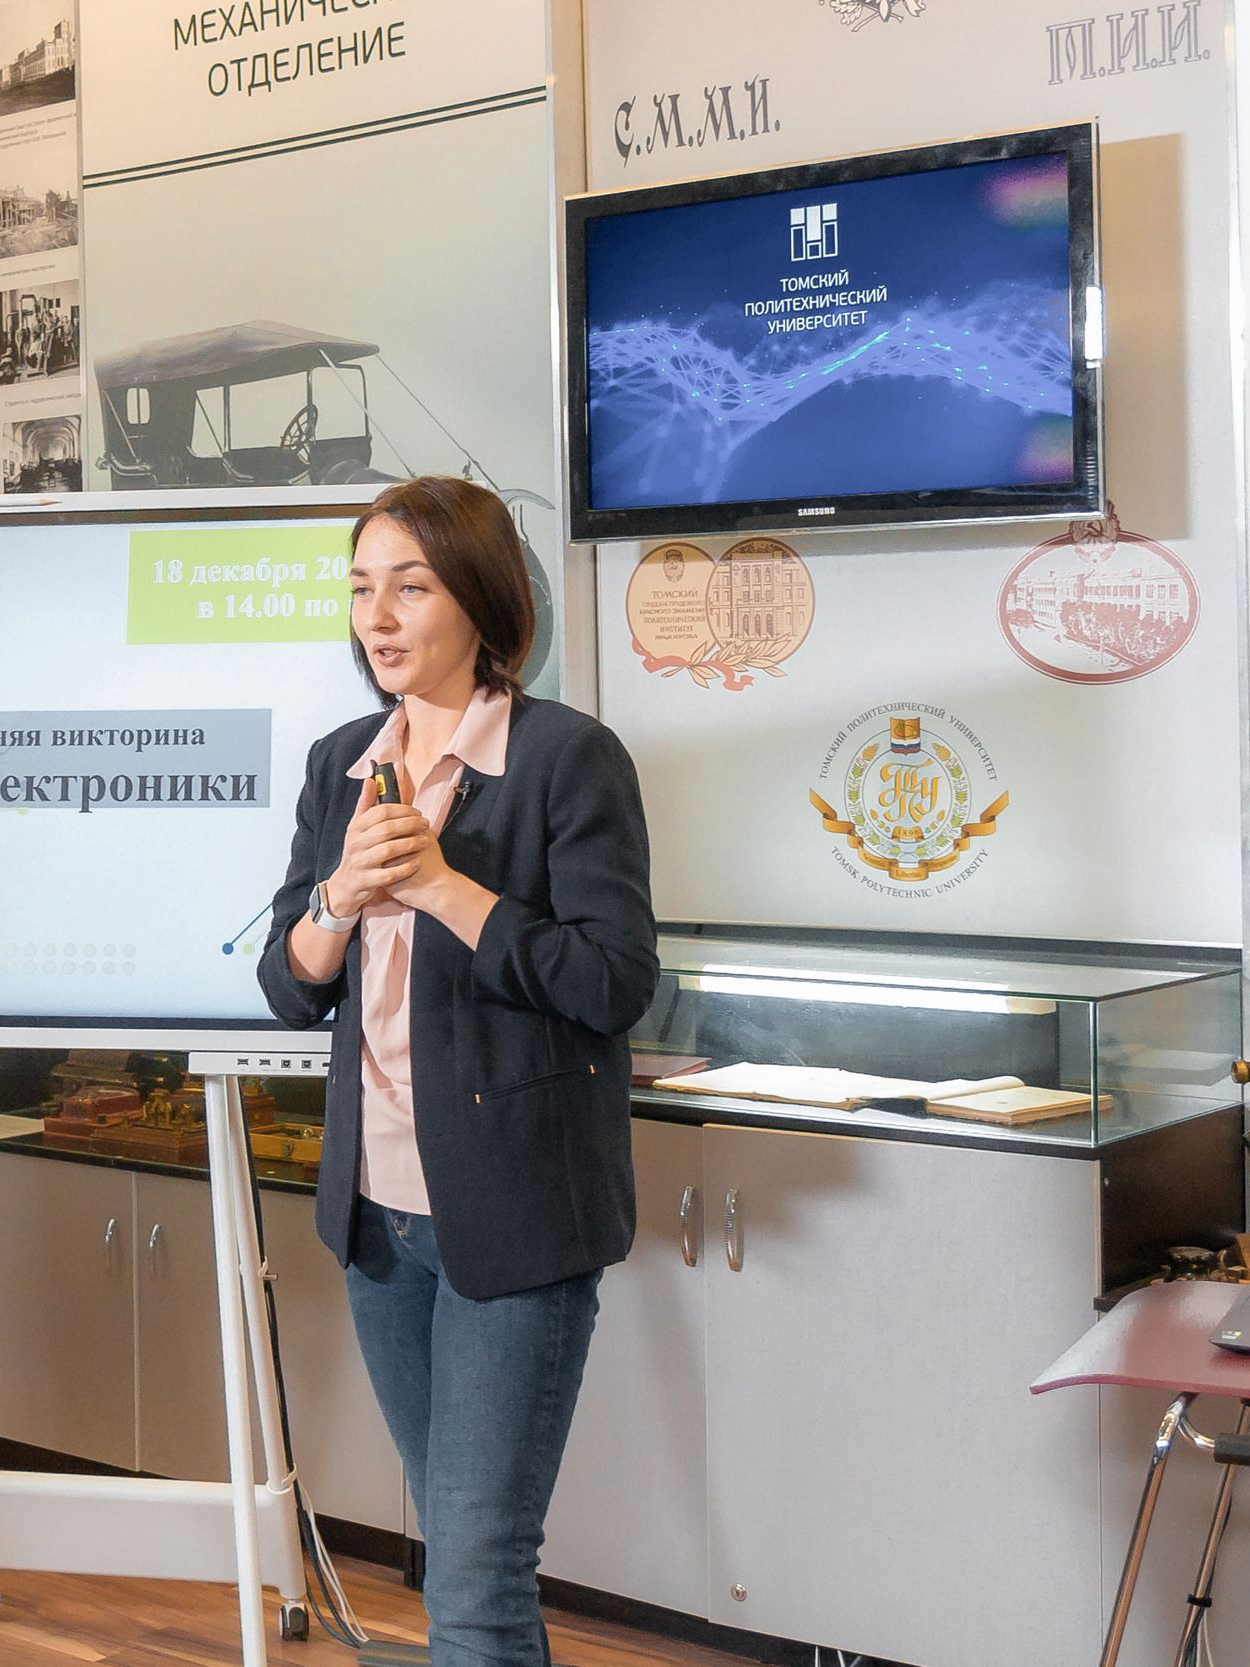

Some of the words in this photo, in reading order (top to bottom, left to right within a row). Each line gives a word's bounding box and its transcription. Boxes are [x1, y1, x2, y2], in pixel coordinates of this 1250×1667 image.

[174, 0, 394, 50] МЕХАНИЧ
[208, 21, 406, 97] ОТДЕЛЕНИЕ
[780, 268, 849, 292] ТОМСКИЙ
[744, 285, 888, 316] ПОЛИТЕХНИЧЕСКИЙ
[767, 310, 868, 335] УНИВЕРСИТЕТ
[797, 506, 836, 517] SAMSUNG
[153, 559, 183, 584] 18
[190, 557, 306, 588] декабря
[314, 555, 350, 581] 20
[197, 600, 215, 619] в
[224, 593, 296, 619] 14.00
[304, 598, 340, 617] по
[652, 587, 698, 599] ТОМСКИЙ
[50, 725, 206, 752] викторина
[819, 730, 847, 780] ТОМСКИЙ
[847, 702, 946, 733] ПОЛИТЕХНИЧЕСКИЙ
[948, 715, 998, 781] УНИВЕРСИТЕТ
[831, 846, 858, 879] TOMSK
[861, 876, 933, 899] POLYTECHNIC
[936, 848, 990, 894] UNIVERSITY
